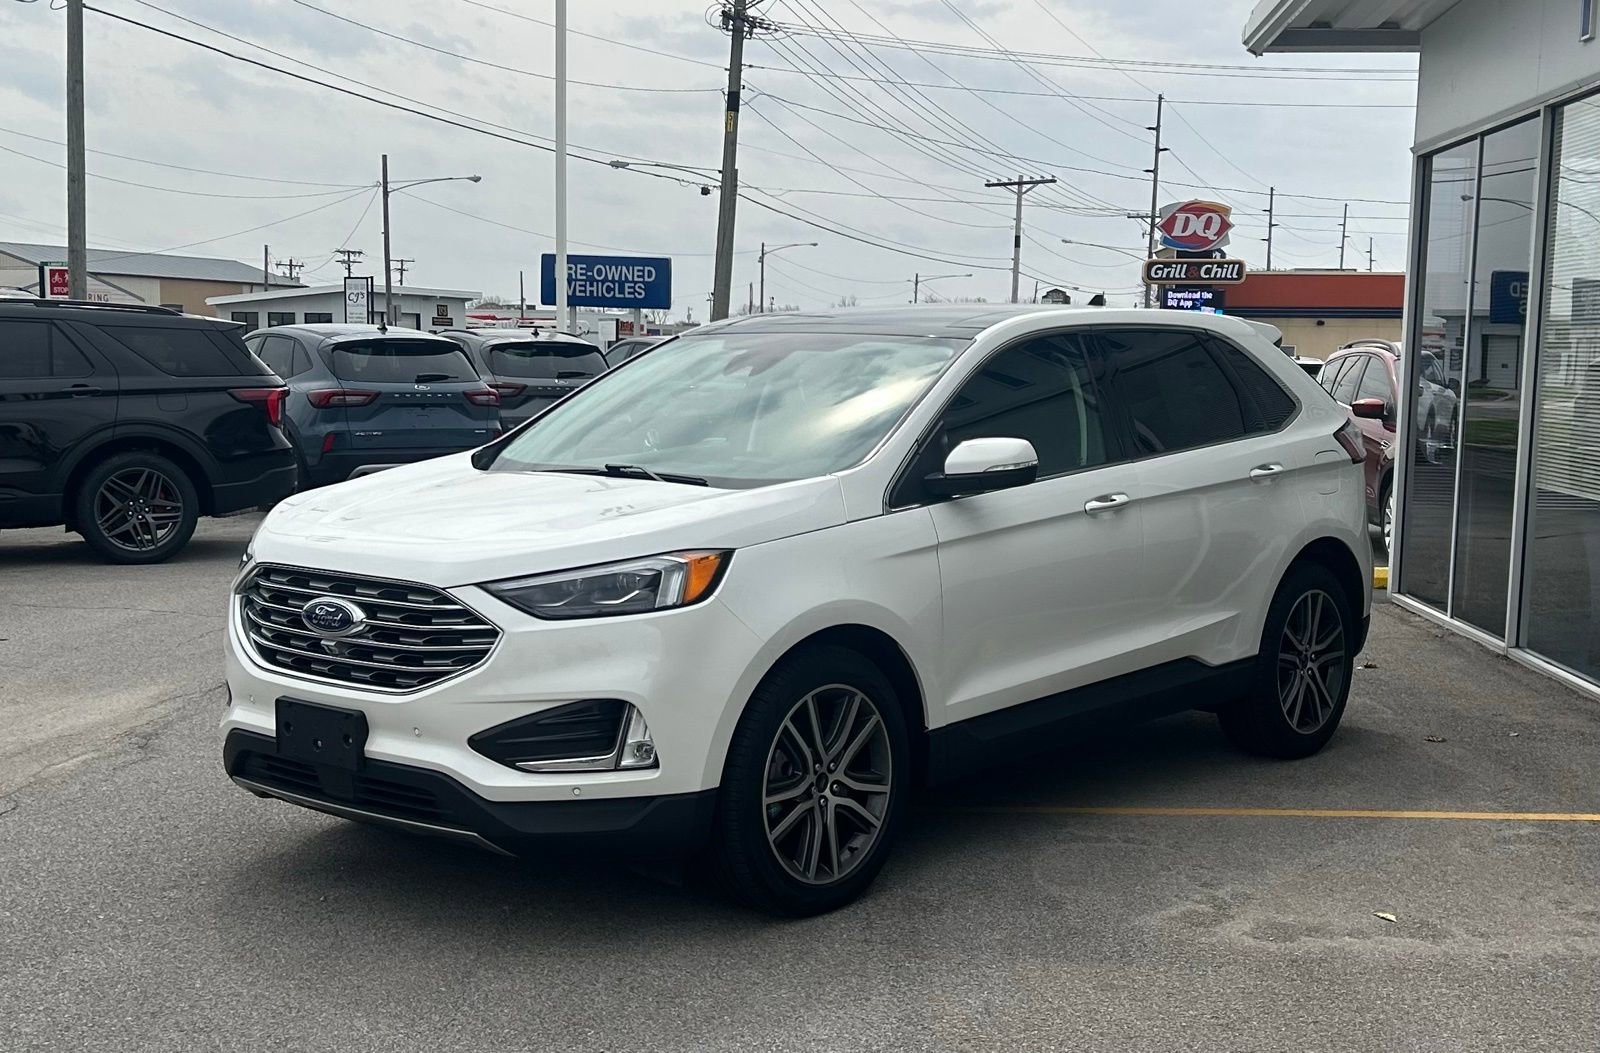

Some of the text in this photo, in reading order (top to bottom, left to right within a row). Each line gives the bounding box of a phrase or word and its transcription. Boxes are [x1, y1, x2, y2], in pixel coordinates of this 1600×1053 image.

[1171, 212, 1222, 241] DQ
[554, 263, 656, 282] RE-OWNED
[1150, 264, 1240, 279] Grill & Chill
[566, 281, 646, 299] VEHICLES
[1167, 291, 1213, 299] Download the
[1179, 299, 1193, 308] App
[312, 605, 343, 627] Ford
